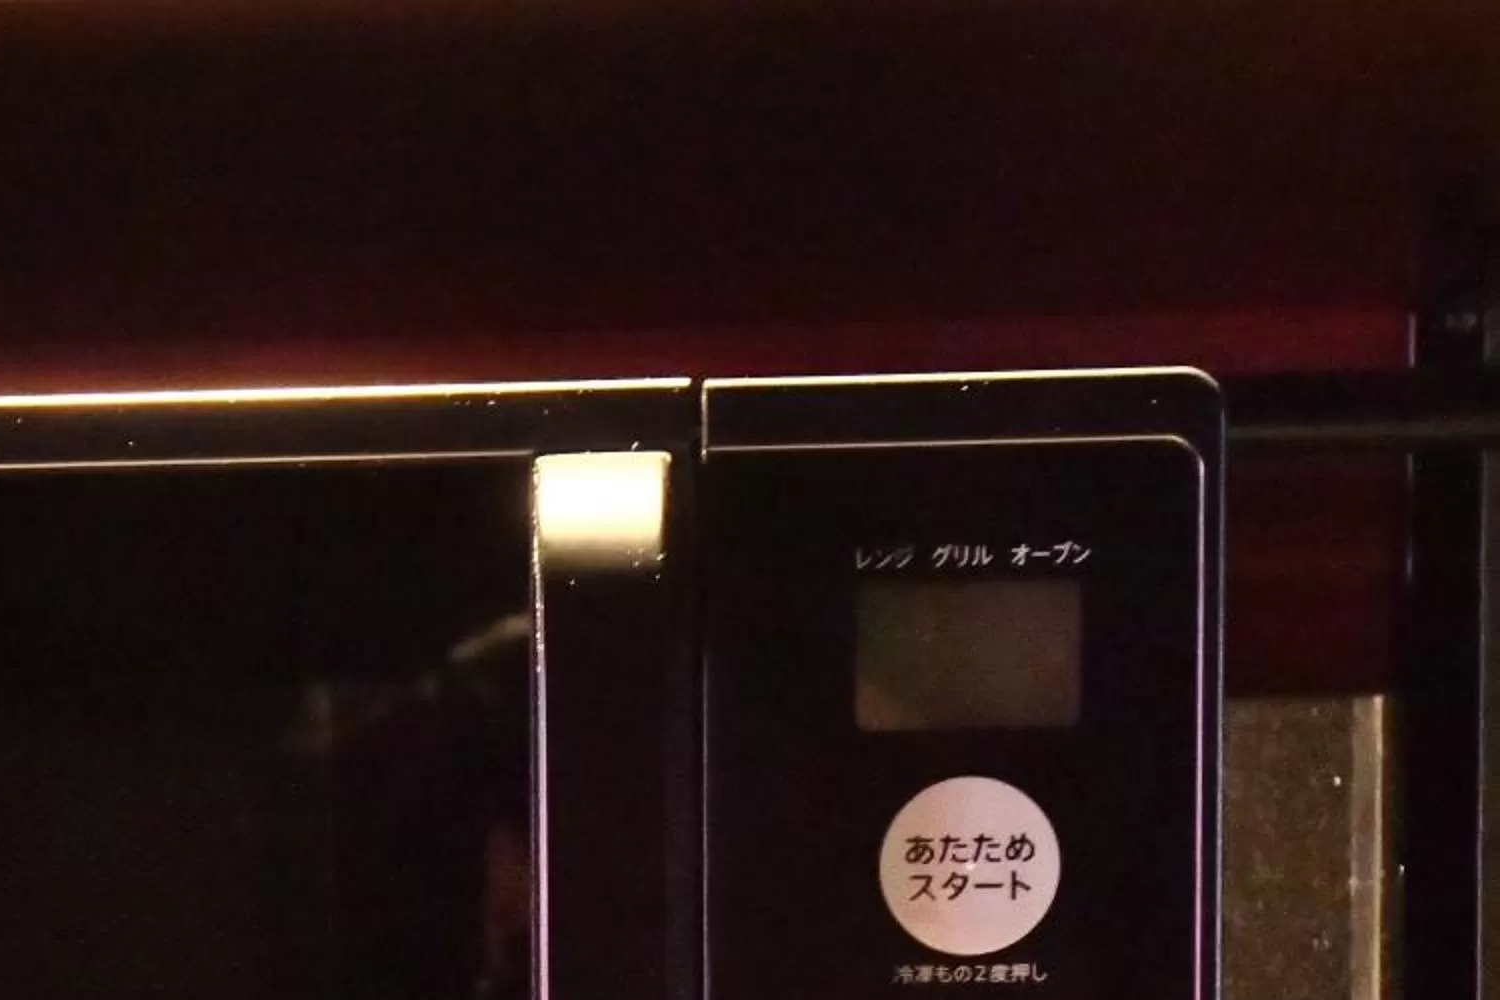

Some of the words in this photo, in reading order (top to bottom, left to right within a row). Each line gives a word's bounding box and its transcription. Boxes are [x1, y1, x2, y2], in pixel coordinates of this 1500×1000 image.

[932, 543, 994, 568] グリル
[1010, 539, 1093, 567] オープン
[903, 832, 1036, 866] あたため
[907, 870, 1033, 902] スタート
